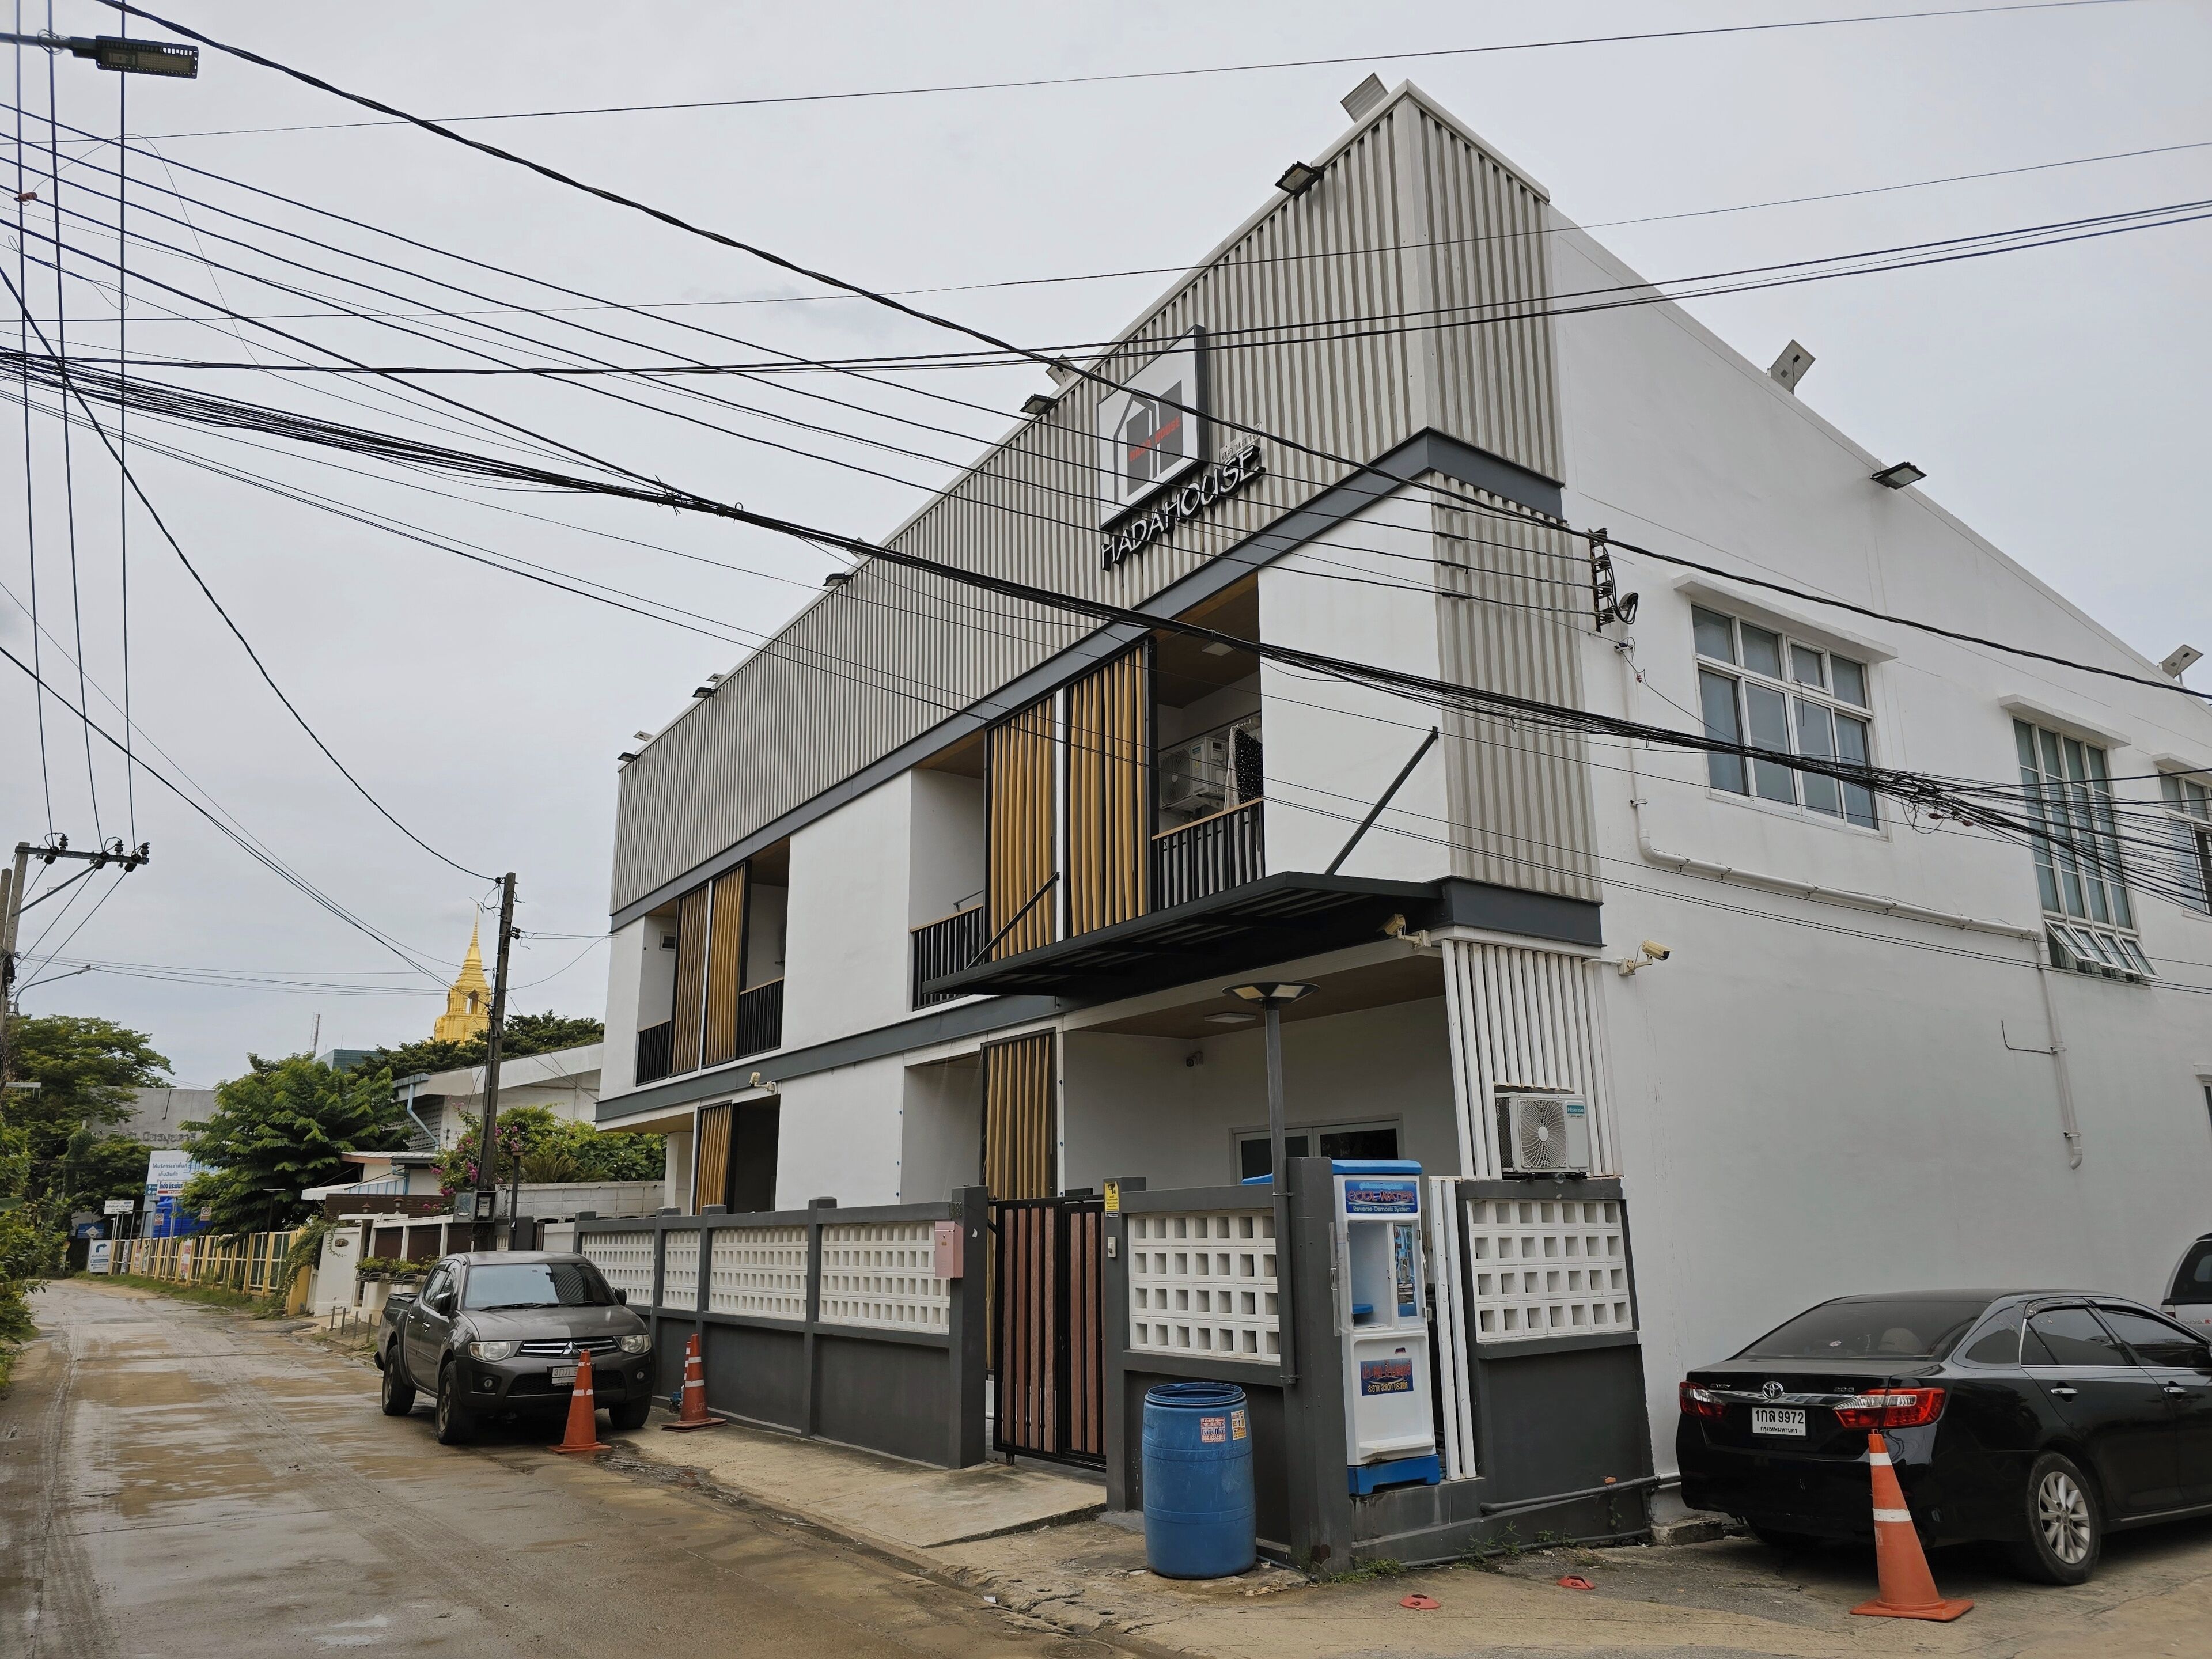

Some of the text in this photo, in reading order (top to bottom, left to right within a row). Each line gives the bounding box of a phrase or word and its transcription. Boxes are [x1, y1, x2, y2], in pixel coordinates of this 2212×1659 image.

[1755, 1409, 1804, 1424] 1กล 9972
[1760, 1426, 1798, 1434] กรุงเทพมหานคร
